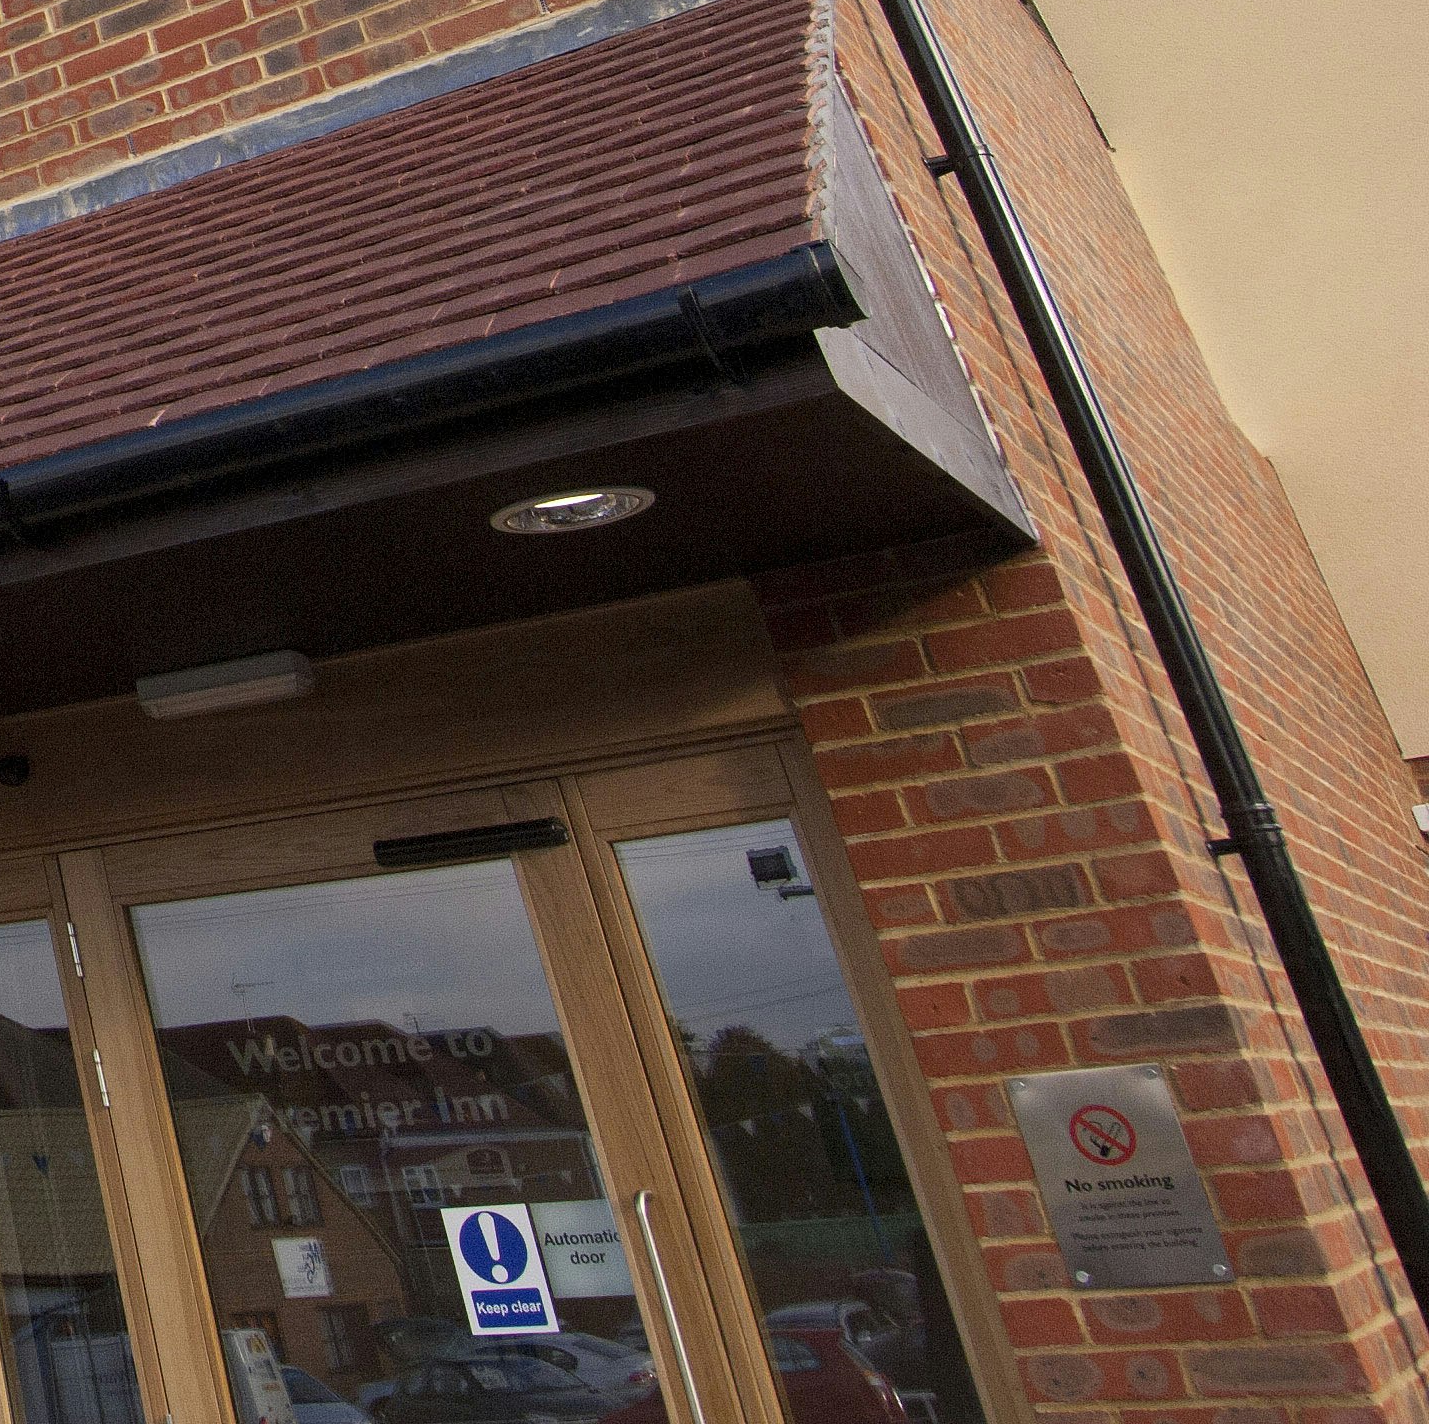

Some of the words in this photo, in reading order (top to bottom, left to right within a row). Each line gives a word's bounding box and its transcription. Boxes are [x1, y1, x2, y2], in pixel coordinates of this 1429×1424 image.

[227, 1032, 434, 1076] Welcome
[445, 1028, 494, 1059] to
[248, 1091, 423, 1136] remier
[434, 1086, 511, 1125] Inn
[1064, 1178, 1093, 1194] No
[1097, 1174, 1175, 1191] smoking
[543, 1229, 622, 1247] Automatic
[569, 1250, 607, 1265] door
[476, 1301, 509, 1317] Keep
[511, 1299, 542, 1314] clear
